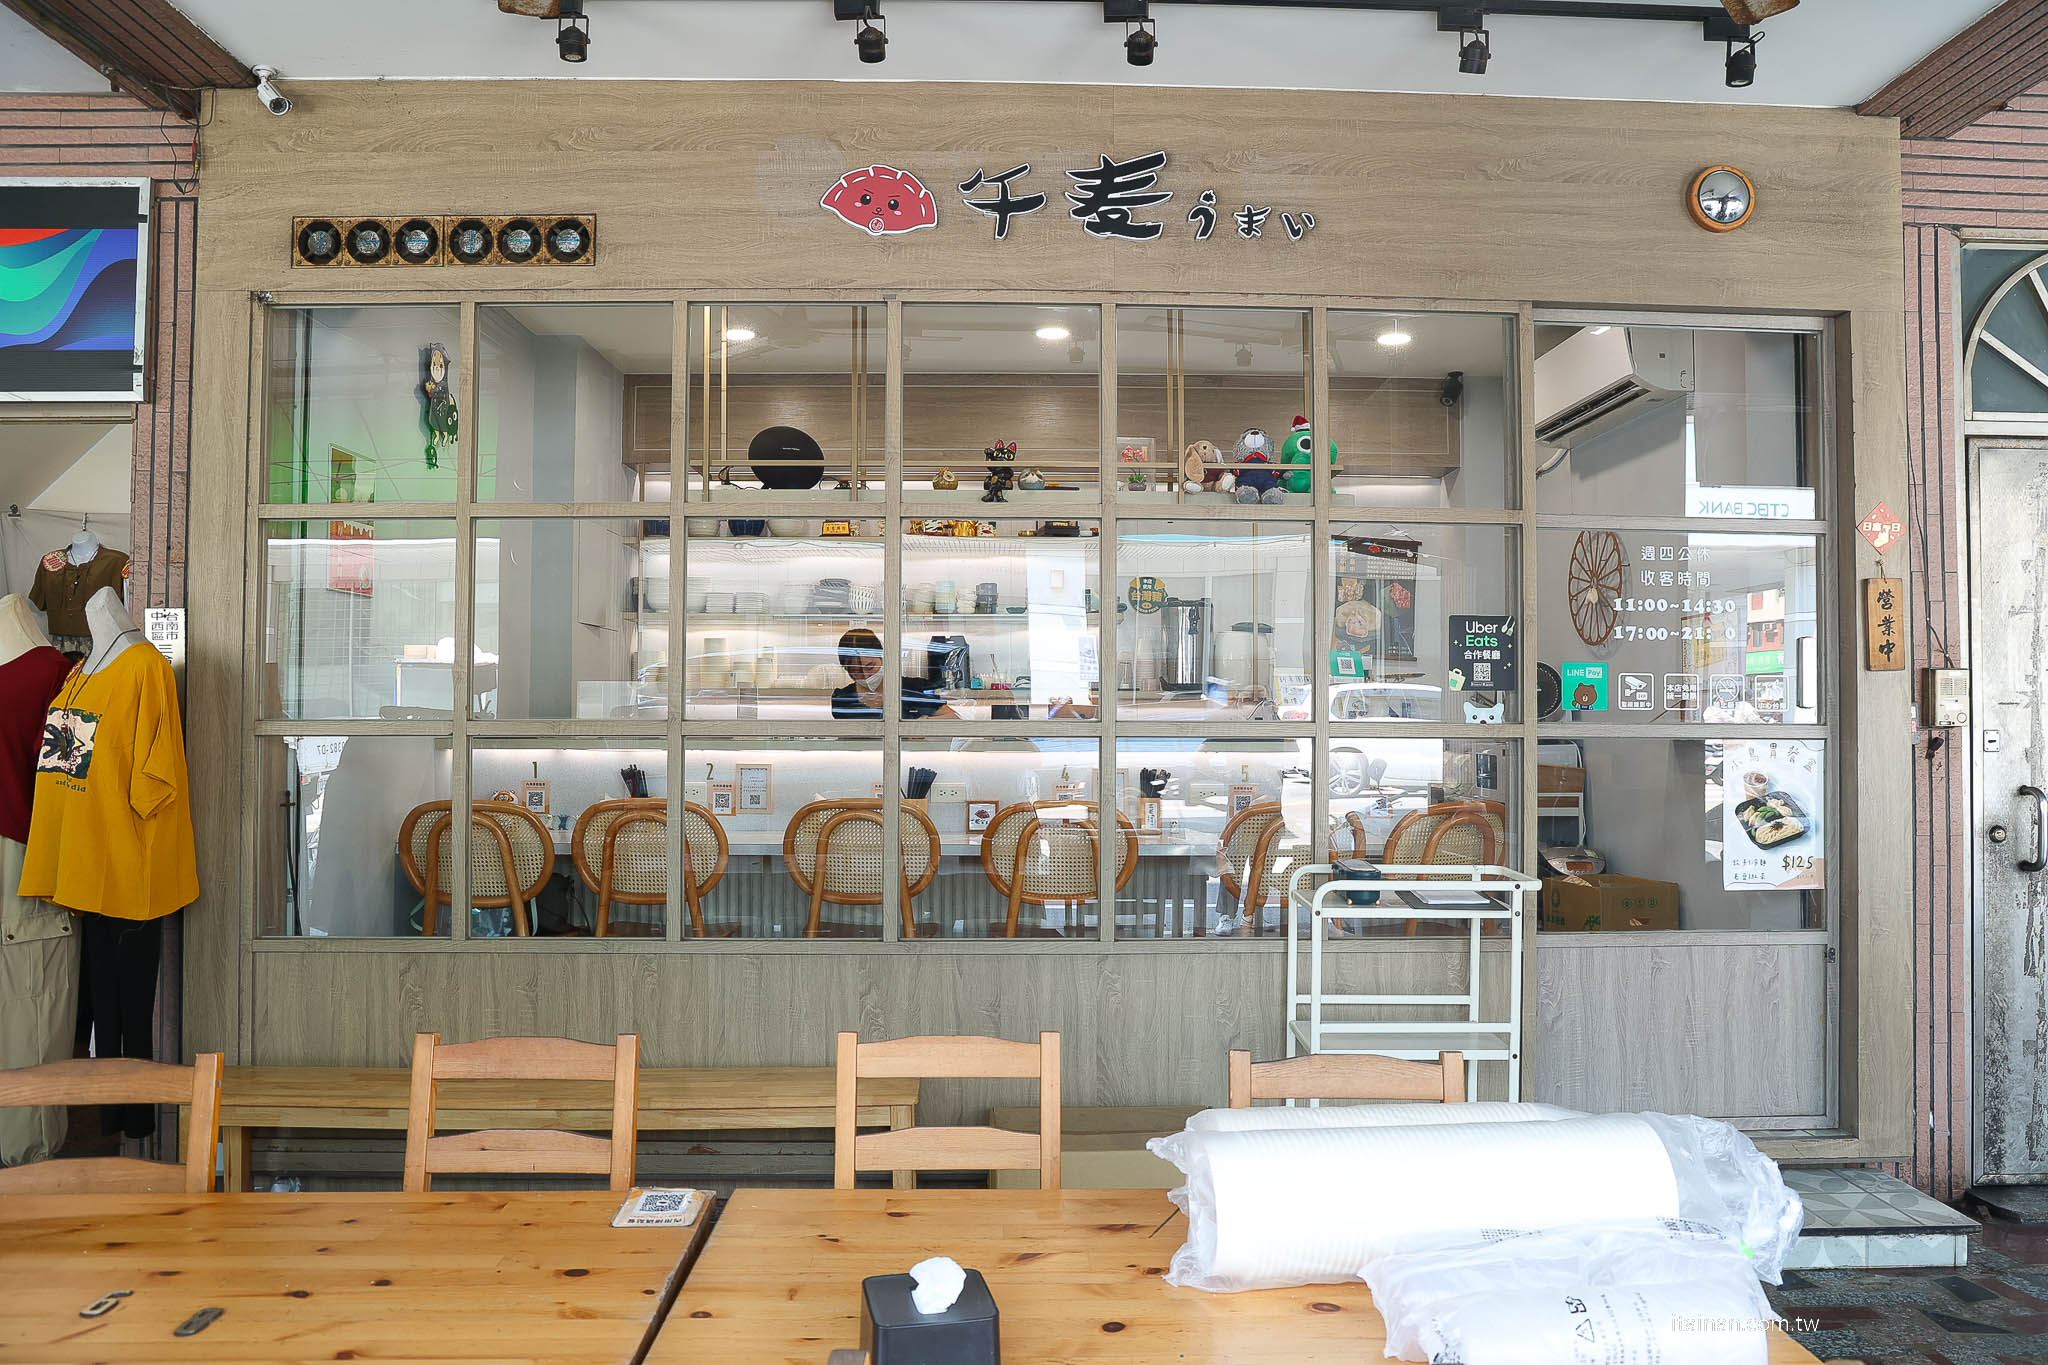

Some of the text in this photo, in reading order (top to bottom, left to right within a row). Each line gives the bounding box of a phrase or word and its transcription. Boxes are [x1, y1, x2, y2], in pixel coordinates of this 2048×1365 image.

[1187, 188, 1317, 241] うまい
[1640, 545, 1711, 562] 週四公休
[1640, 569, 1711, 587] 收客時間
[1613, 598, 1736, 614] 11:00~14:30
[1465, 621, 1498, 634] Uber
[1613, 625, 1736, 641] 17:00~21:0
[1876, 588, 1896, 662] 營業中
[1465, 635, 1498, 647] Eats
[1463, 649, 1501, 660] 合作餐廳
[1567, 668, 1601, 679] LINE Pay
[532, 761, 538, 778] 1
[706, 762, 714, 780] 2
[1781, 854, 1813, 871] $125
